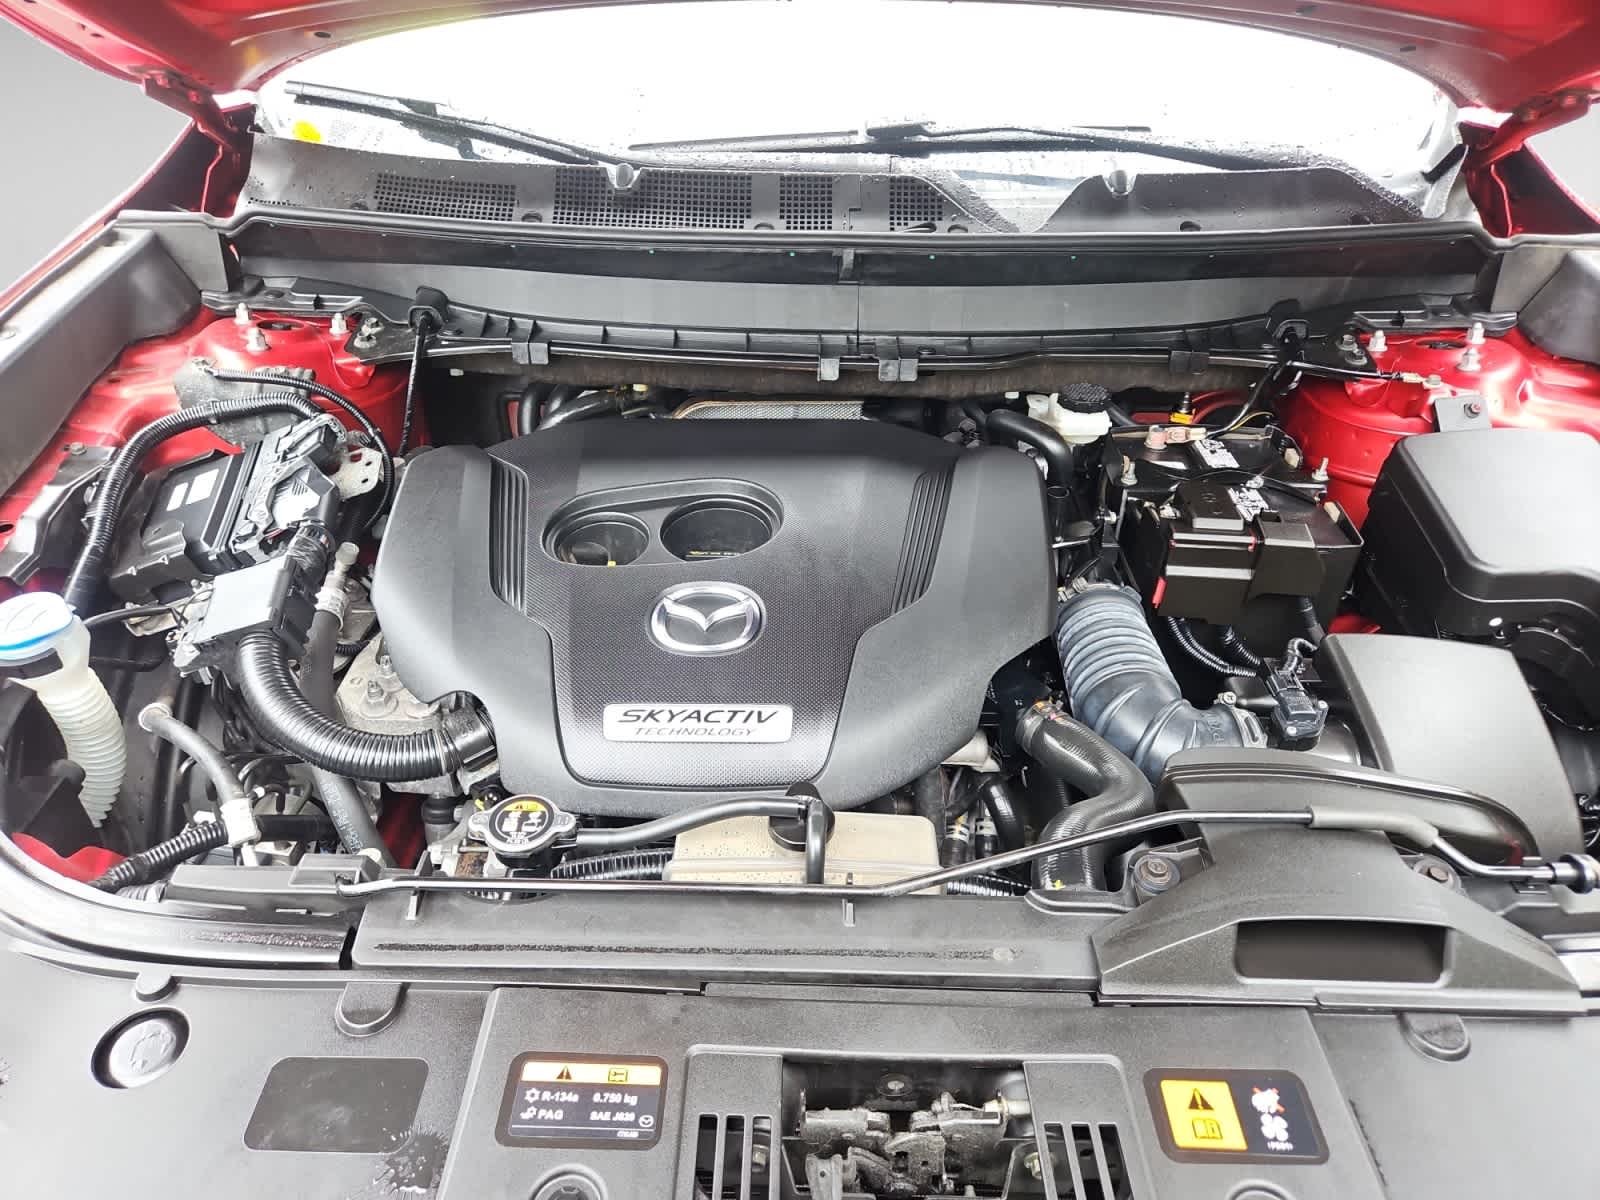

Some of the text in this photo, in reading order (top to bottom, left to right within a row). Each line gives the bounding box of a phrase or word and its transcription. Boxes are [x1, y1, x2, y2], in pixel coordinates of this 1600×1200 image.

[617, 708, 780, 724] SKYACTIV
[634, 727, 757, 737] TECHNOLOGY
[541, 1090, 580, 1102] R-134a
[623, 1093, 638, 1106] kg
[537, 1108, 564, 1120] PAG
[589, 1110, 611, 1121] SAE
